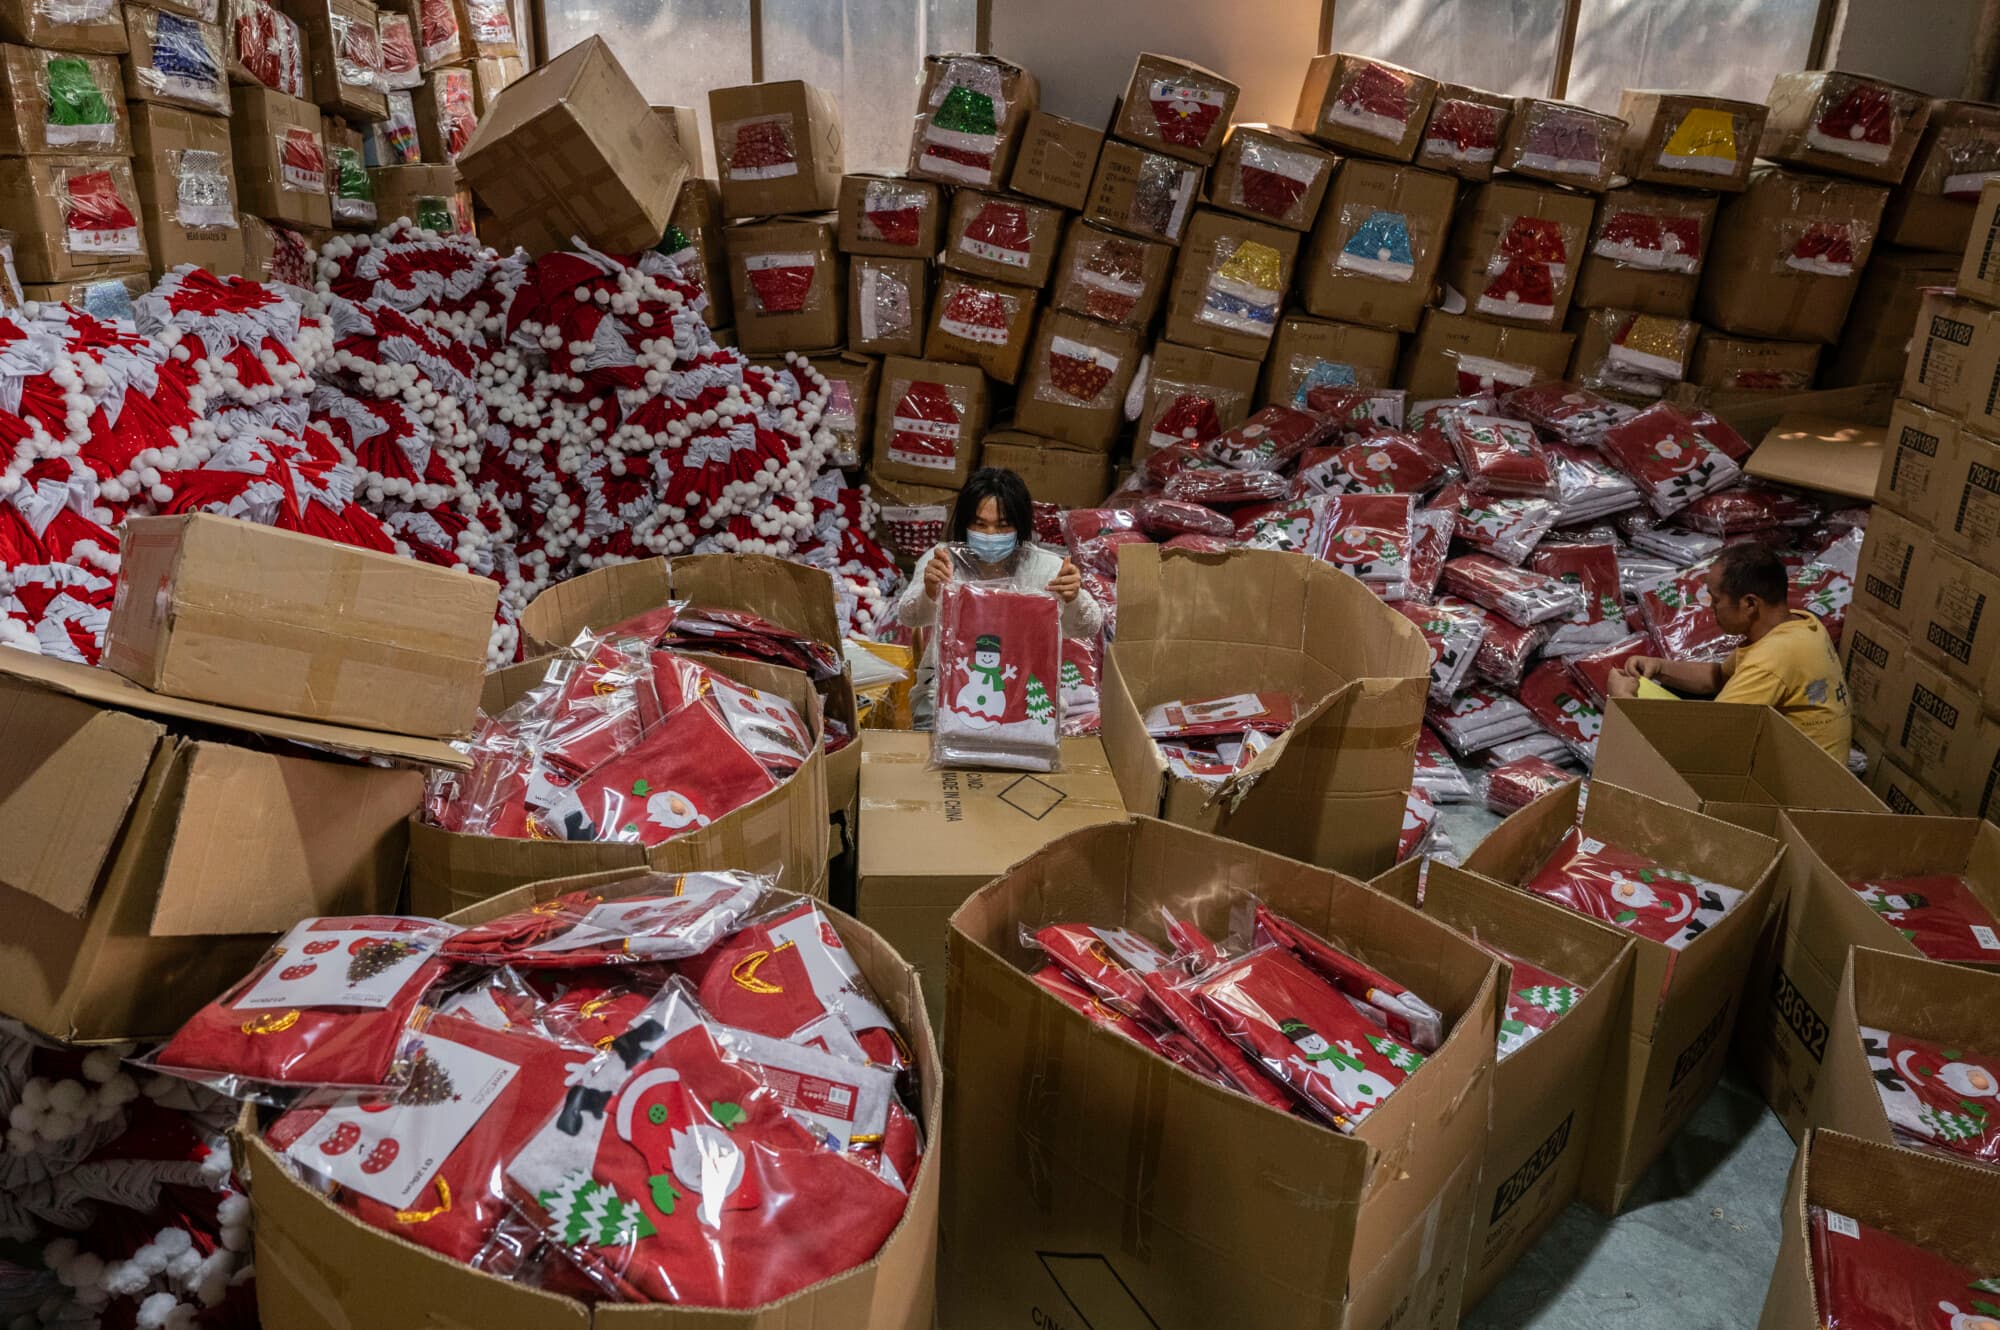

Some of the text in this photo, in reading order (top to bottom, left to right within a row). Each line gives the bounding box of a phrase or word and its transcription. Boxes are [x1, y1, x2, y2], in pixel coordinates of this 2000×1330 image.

[1931, 317, 1973, 345] 7991188
[1902, 428, 1937, 456] 7991188
[1970, 463, 2000, 492] 79911
[1929, 624, 1969, 662] 7991188
[1915, 685, 1956, 728] 7991188
[941, 772, 958, 790] MADE
[944, 799, 963, 822] CHINA
[1775, 973, 1826, 1059] 28632
